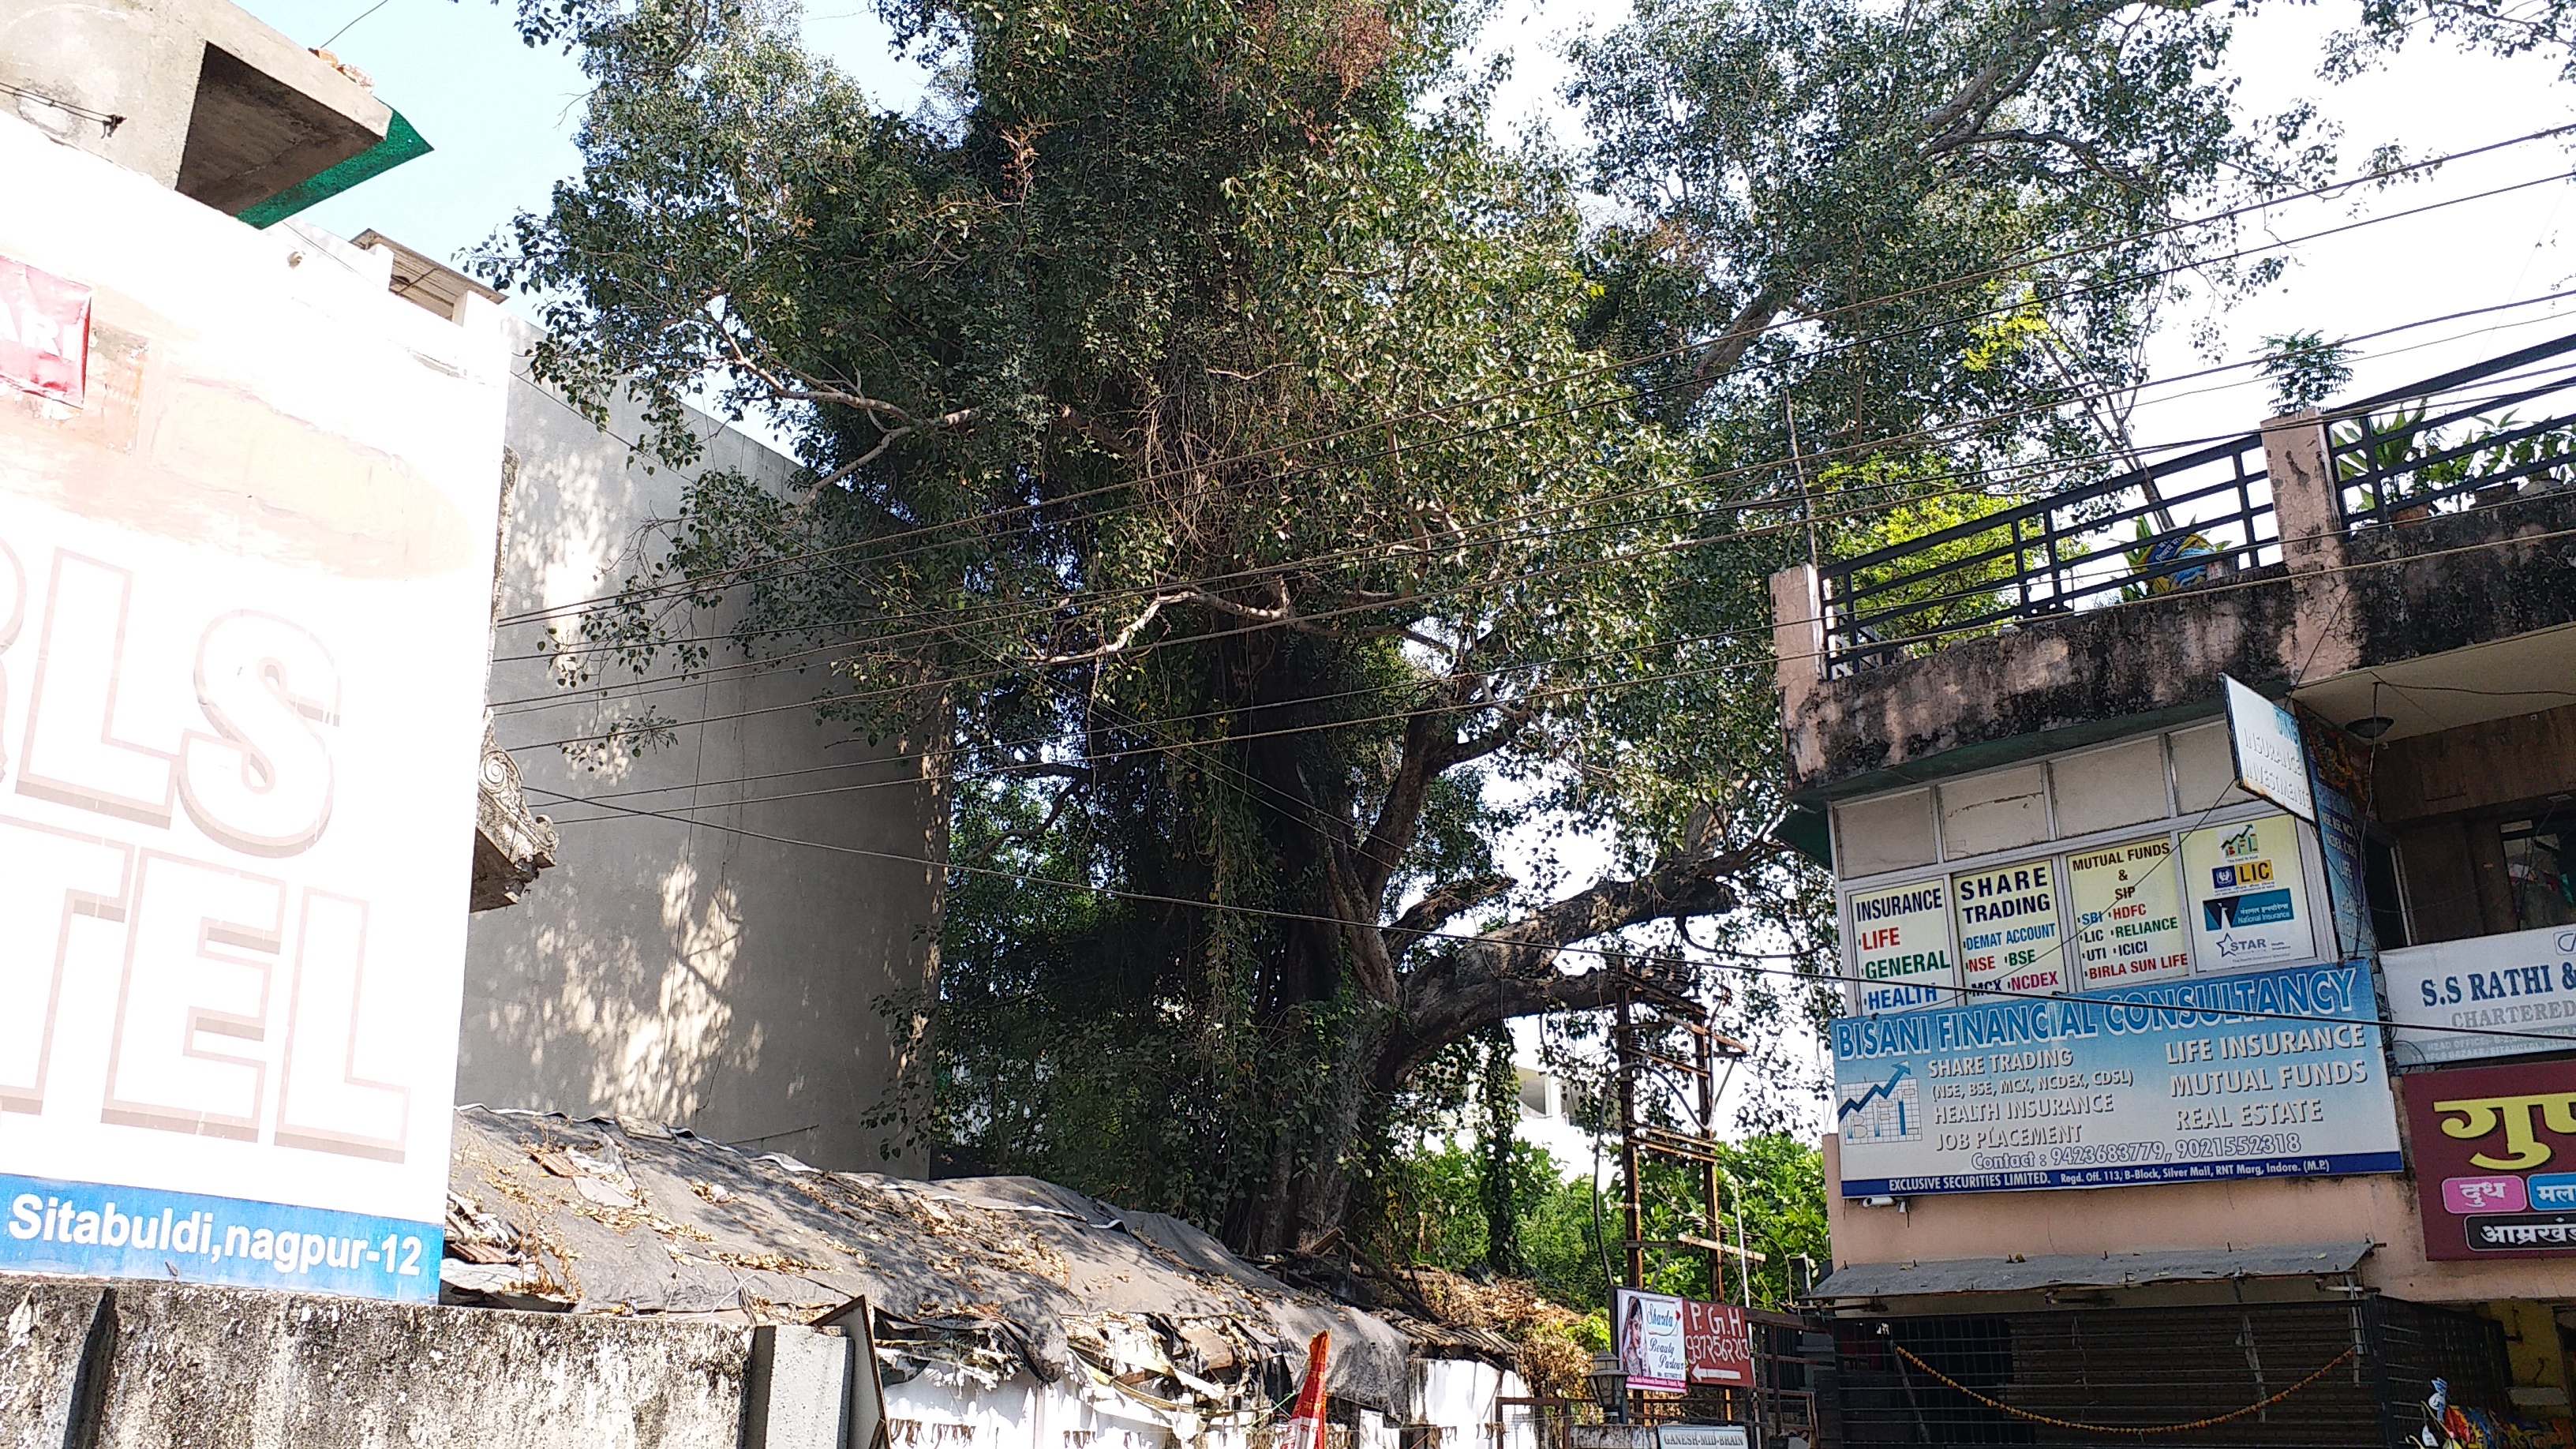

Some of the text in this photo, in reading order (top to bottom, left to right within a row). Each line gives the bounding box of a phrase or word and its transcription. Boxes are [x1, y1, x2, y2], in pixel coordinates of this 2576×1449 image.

[0, 535, 341, 859] LS
[2072, 842, 2170, 871] MUTUAL FUNDS
[1960, 867, 2048, 900] SHARE
[2118, 869, 2129, 882] &
[2239, 862, 2270, 882] LIC
[1856, 889, 1942, 922] INSURANCE
[2115, 886, 2136, 901] SIP
[1963, 893, 2050, 924] TRADING
[2081, 904, 2147, 925] SBI HDFC
[2237, 911, 2290, 923] National Insurance
[1862, 927, 1900, 951] LIFE
[1967, 923, 2056, 950] DEMAT ACCOUNT
[2085, 917, 2178, 944] LIC RELIANCE
[2087, 941, 2148, 961] UTI ICICI
[2230, 938, 2267, 952] STAR
[1865, 950, 1950, 979] GENERAL
[1968, 949, 2036, 972] NSE BSE
[2089, 953, 2188, 979] BIRLA SUN LIFE
[1868, 984, 1938, 1010] HEALTH
[1972, 972, 2058, 998] MCX NCDEX
[2421, 976, 2462, 1007] S.S
[2468, 964, 2554, 1002] RATHI
[1836, 968, 2357, 1061] BISANI FINANCIAL CONSULTANCY
[2451, 999, 2576, 1028] CHARTERED
[2165, 1025, 2367, 1064] LIFE INSURANCE
[1929, 1049, 2073, 1078] SHARE TRADING
[1969, 1082, 1997, 1098] BSE,
[2001, 1080, 2035, 1095] MCX,
[2039, 1073, 2090, 1092] NCDEX,
[2170, 1061, 2368, 1097] MUTUAL FUNDS
[1934, 1094, 2114, 1124] HEALTH INSURANCE
[2176, 1099, 2323, 1131] REAL ESTATE
[1936, 1125, 2083, 1151] JOB PLACEMENT
[1971, 1150, 2035, 1170] Contact
[2175, 1133, 2301, 1159] 9021552318
[1889, 1177, 1941, 1192] EXCLUSIVE
[1943, 1175, 2001, 1189] SECURITIES
[2005, 1173, 2051, 1186] LIMITED.
[2061, 1172, 2084, 1184] Regd.
[2125, 1167, 2162, 1180] B-Block,
[2162, 1166, 2188, 1178] Silver
[2215, 1163, 2233, 1176] RNT
[2237, 1163, 2264, 1177] Marg,
[2267, 1161, 2301, 1174] Indore.
[1649, 1337, 1675, 1357] Beauty
